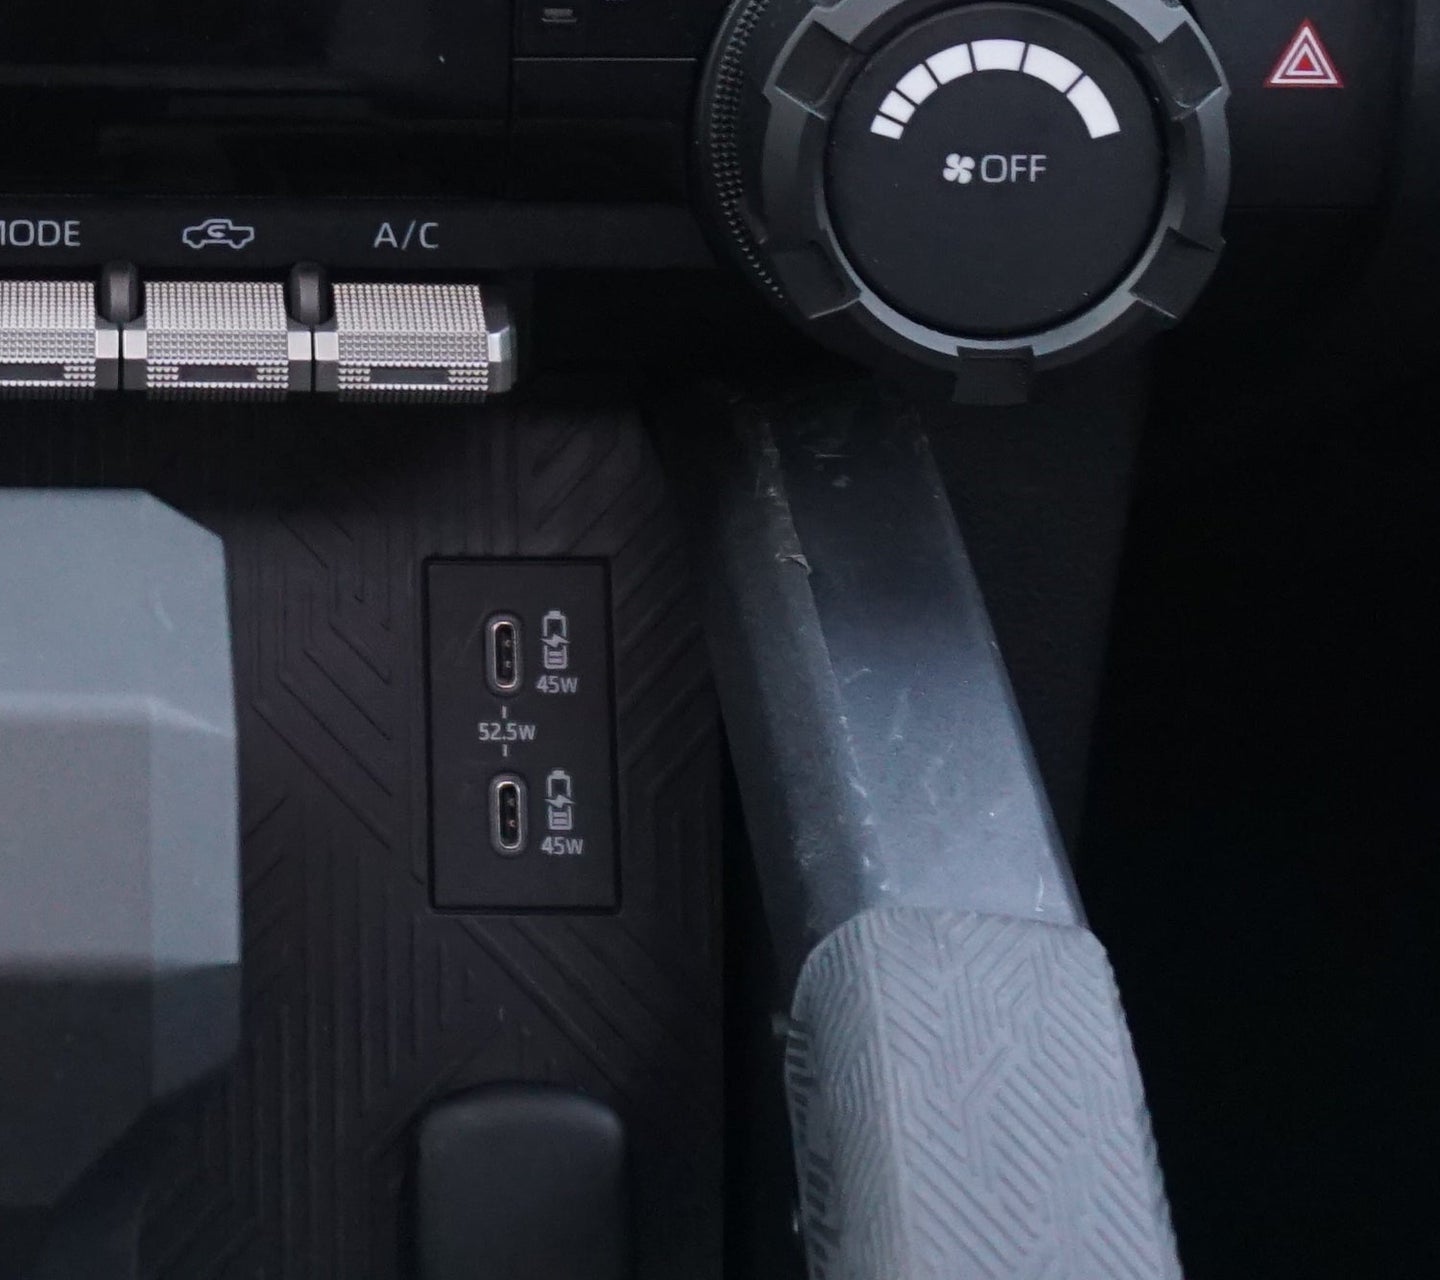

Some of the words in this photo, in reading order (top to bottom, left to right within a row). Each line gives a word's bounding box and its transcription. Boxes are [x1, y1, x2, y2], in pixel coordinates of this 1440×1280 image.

[980, 154, 1047, 183] OFF
[372, 219, 440, 251] A/C
[535, 676, 579, 694] 45W
[477, 723, 537, 741] 52.5W
[540, 837, 584, 856] 45W
